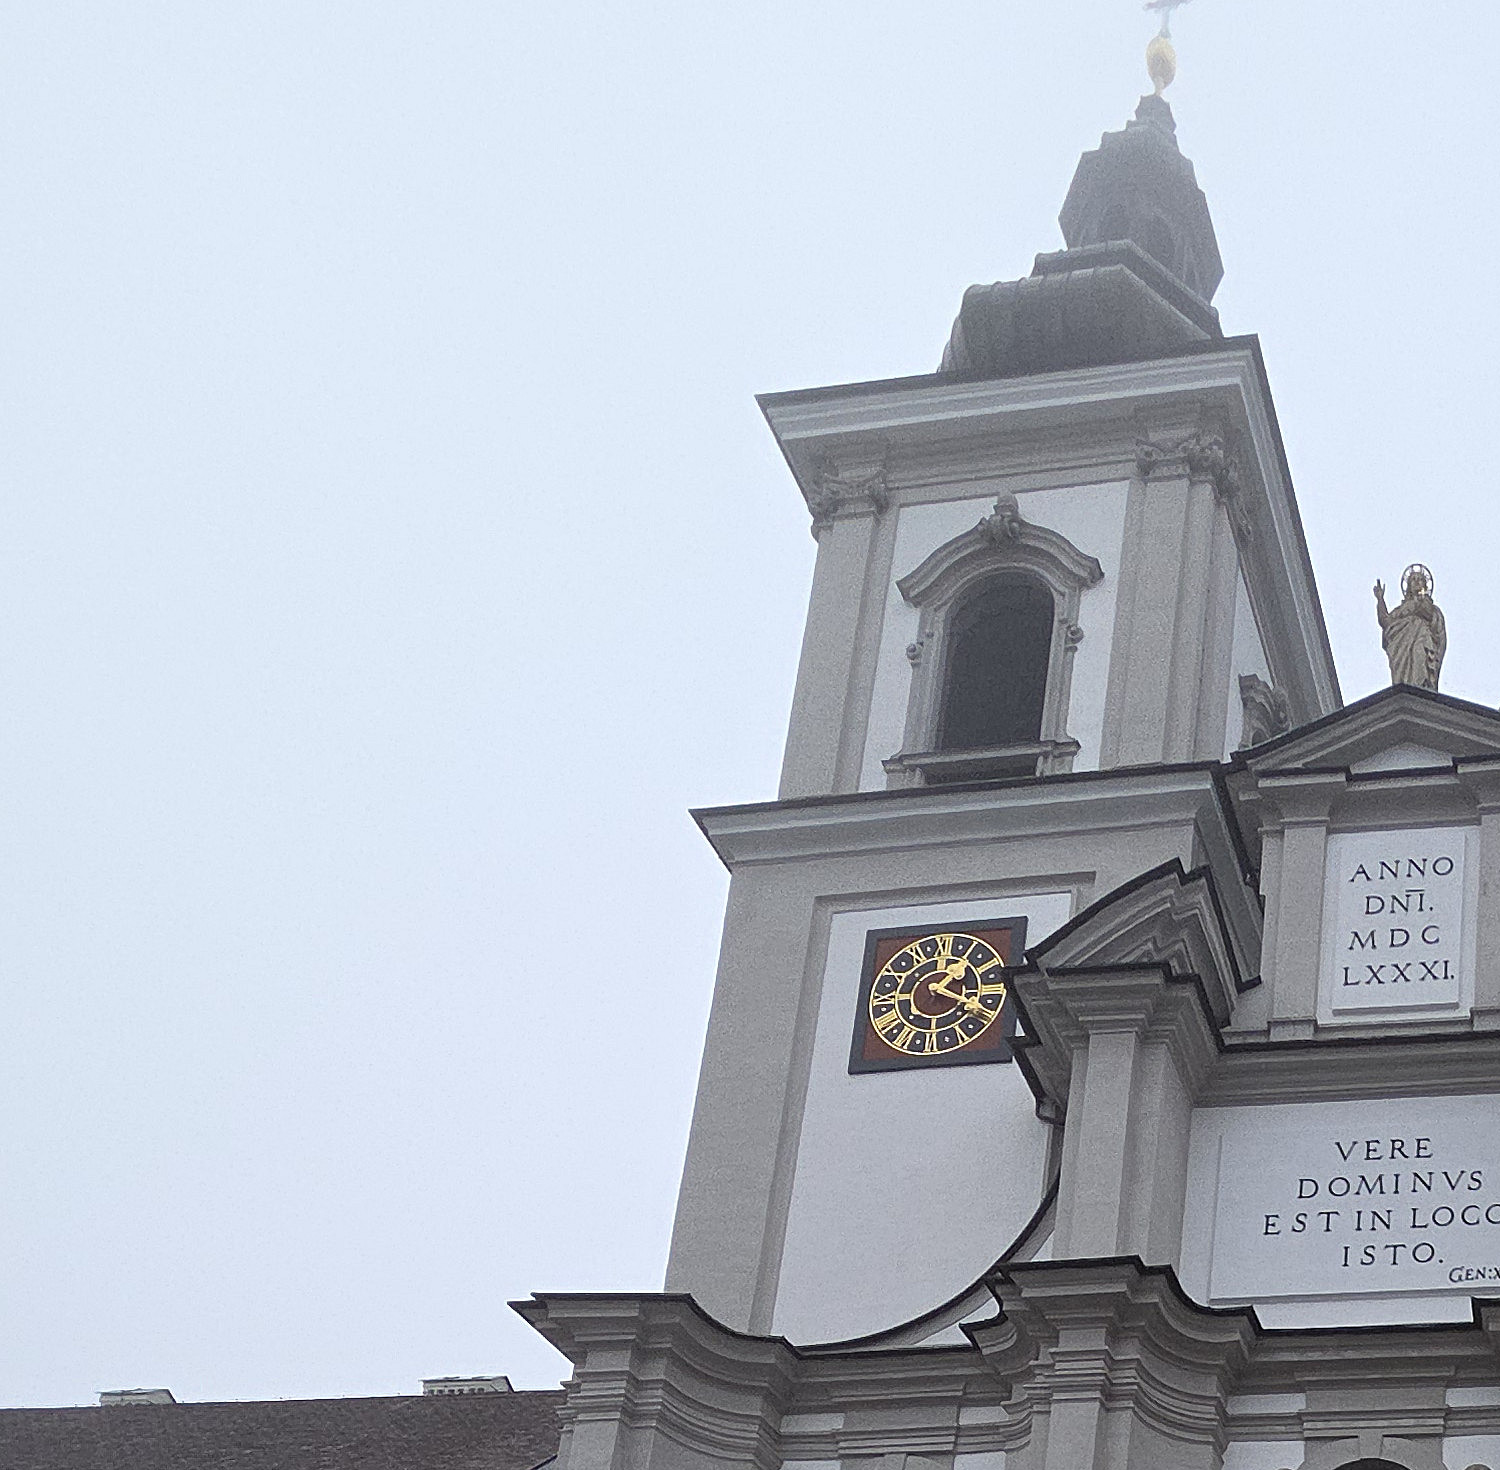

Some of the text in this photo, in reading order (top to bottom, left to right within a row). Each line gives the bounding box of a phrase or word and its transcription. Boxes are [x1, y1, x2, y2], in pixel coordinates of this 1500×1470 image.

[1348, 856, 1454, 882] ANNO
[1343, 960, 1455, 986] LXXXI.
[1335, 1137, 1433, 1162] VERE
[1298, 1170, 1483, 1199] DOMINVS
[1263, 1210, 1340, 1235] EST
[1355, 1209, 1393, 1231] IN
[1342, 1242, 1444, 1267] ISTO.
